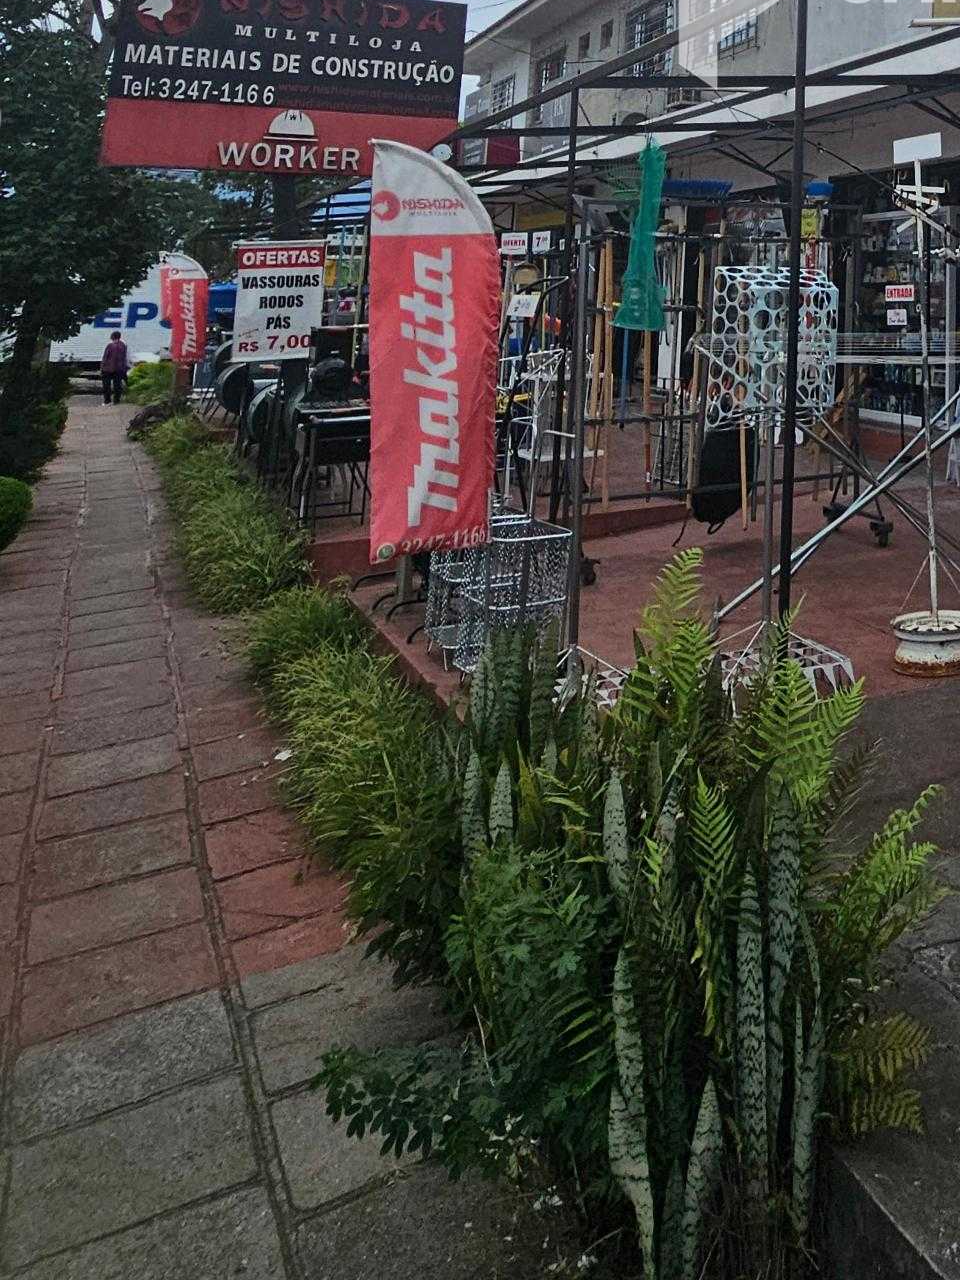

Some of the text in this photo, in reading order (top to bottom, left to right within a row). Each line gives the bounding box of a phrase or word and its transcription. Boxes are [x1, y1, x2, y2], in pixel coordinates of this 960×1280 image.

[234, 24, 423, 52] MULTILOJA
[124, 43, 455, 86] MATERIAIS DE CONSTRUÇÃO
[217, 141, 361, 171] WORKER
[243, 250, 320, 266] OFERTAS
[242, 274, 320, 290] VASSOURAS
[886, 287, 913, 299] ENTRADA
[259, 295, 304, 309] RODOS
[266, 314, 291, 330] PÁS
[238, 334, 311, 352] R$ 7,00
[401, 247, 458, 527] makita
